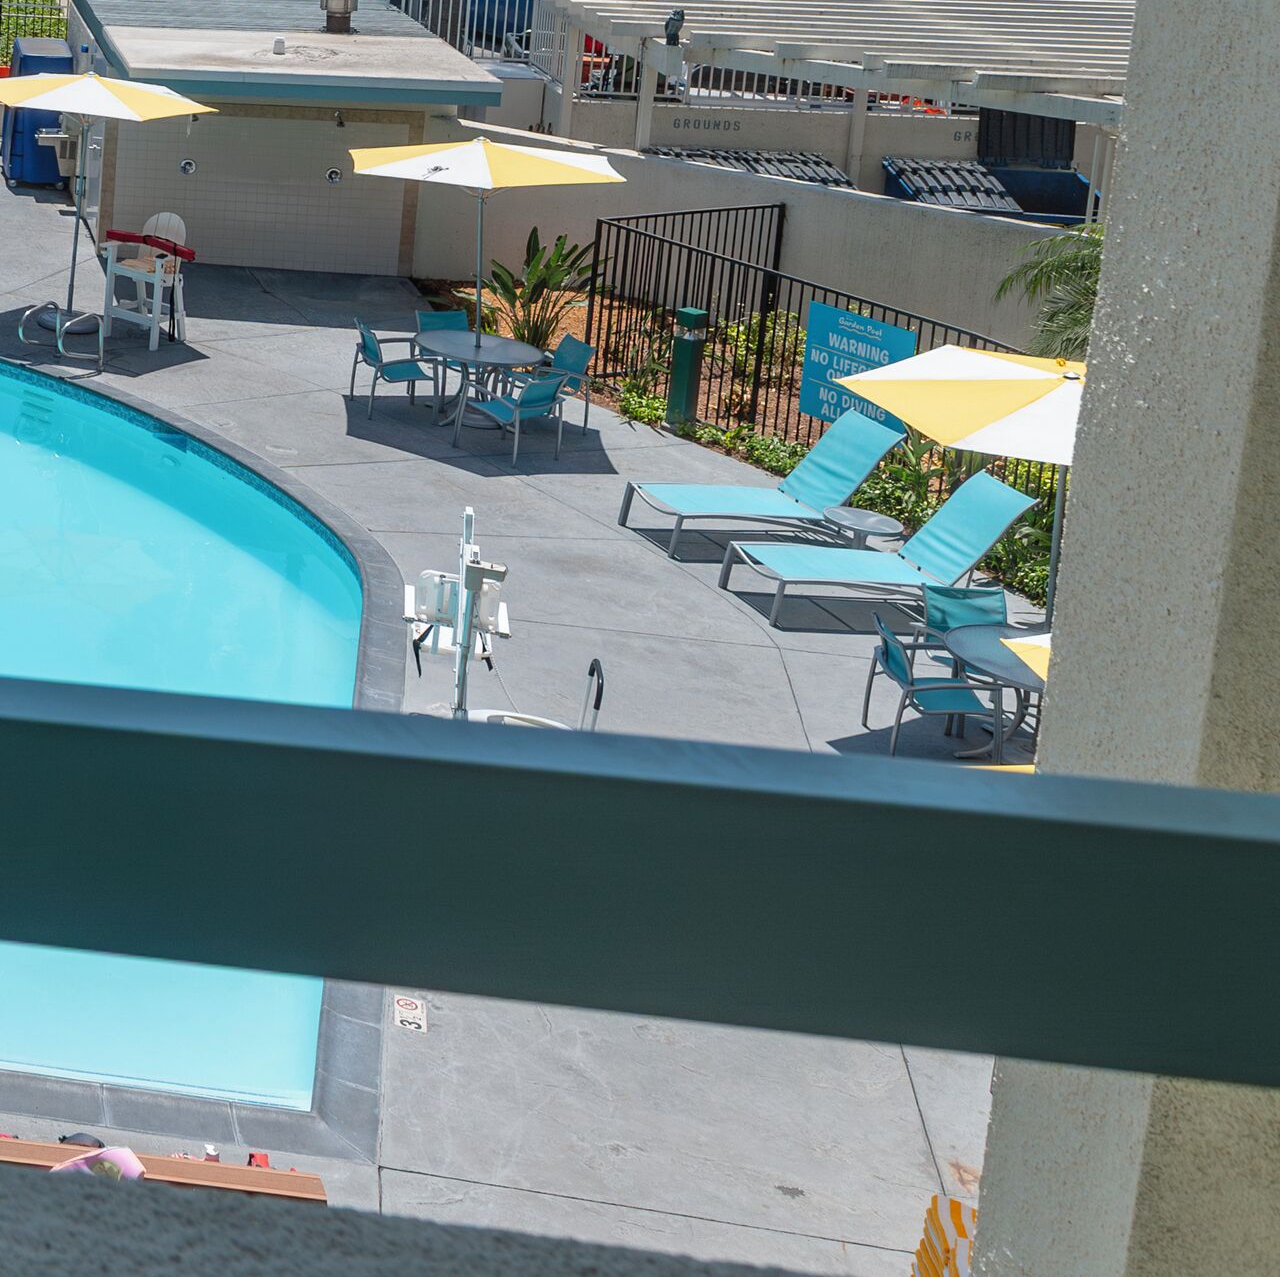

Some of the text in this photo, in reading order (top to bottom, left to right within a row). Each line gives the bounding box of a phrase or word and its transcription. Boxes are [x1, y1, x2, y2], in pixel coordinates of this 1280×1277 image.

[673, 118, 741, 131] GROUNDS
[838, 316, 865, 332] Garden
[867, 325, 882, 337] Pool
[810, 348, 829, 365] NO
[828, 332, 890, 364] WARNING
[819, 387, 837, 404] NO
[841, 395, 886, 421] DIVING
[400, 1019, 422, 1030] 3
